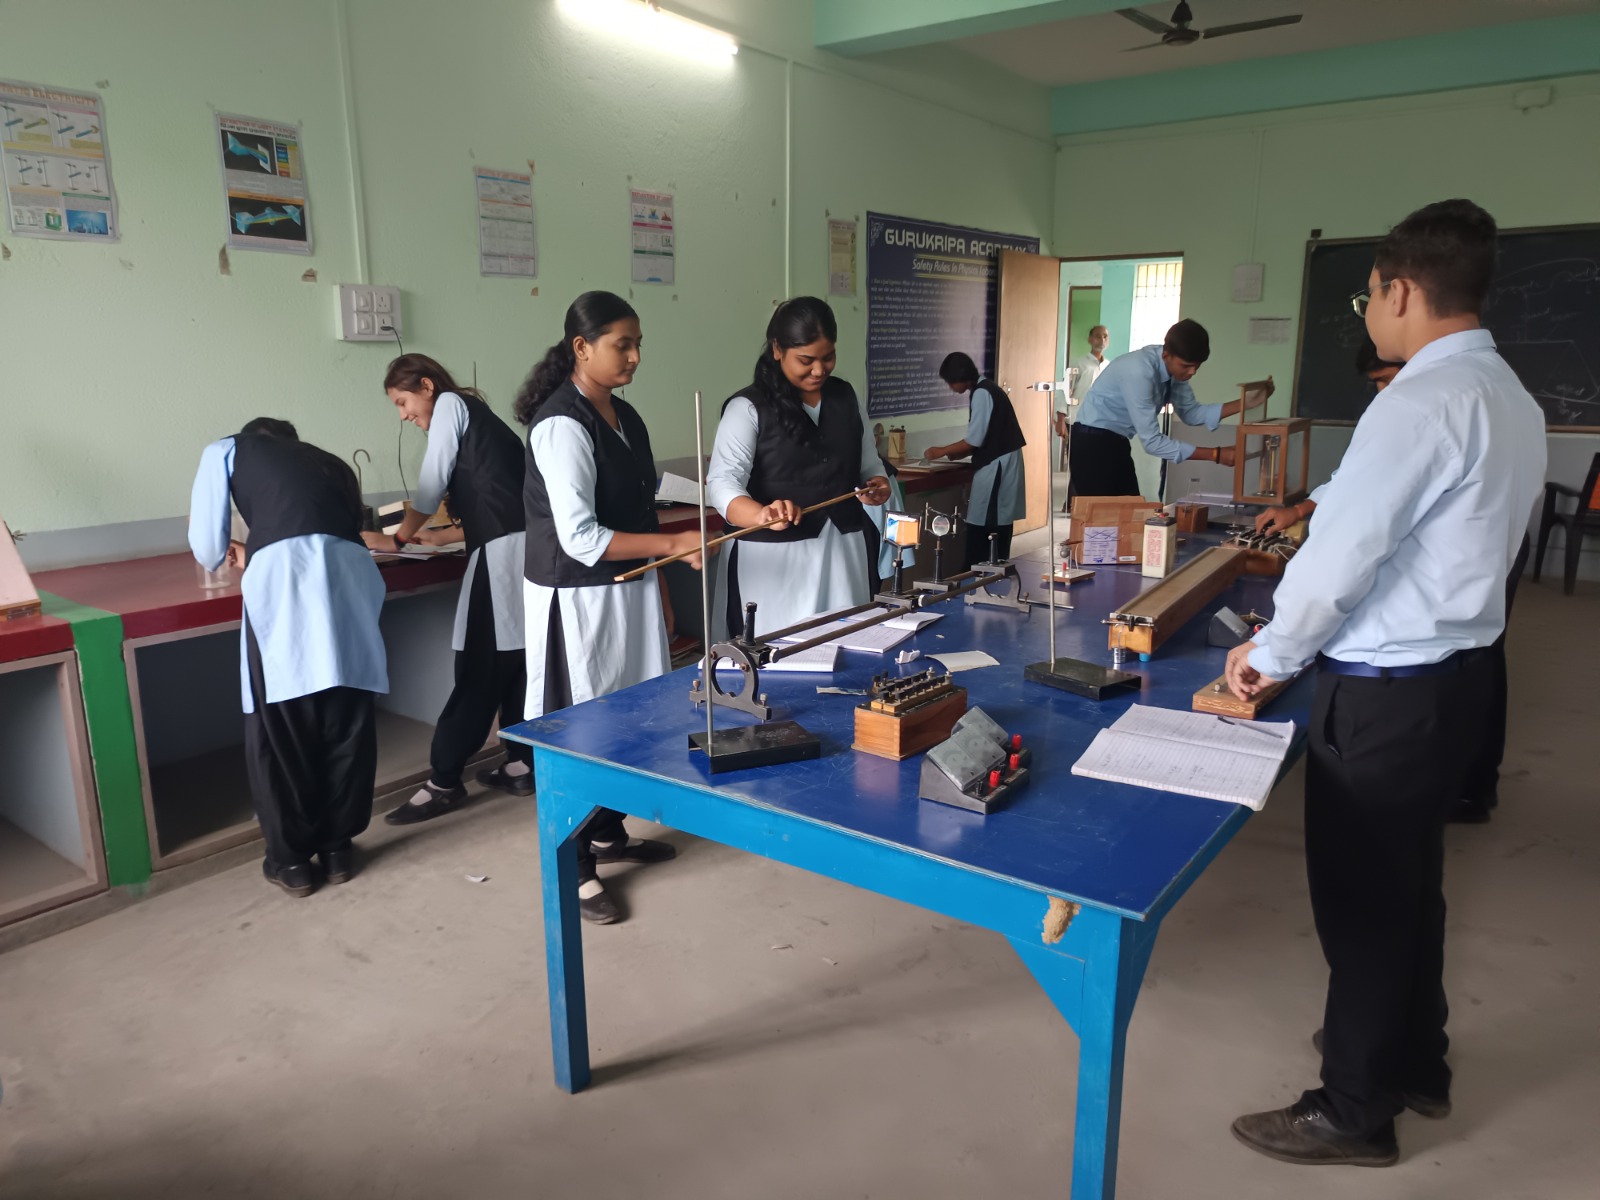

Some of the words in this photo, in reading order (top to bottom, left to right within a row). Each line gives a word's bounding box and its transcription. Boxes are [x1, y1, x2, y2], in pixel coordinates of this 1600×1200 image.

[885, 229, 965, 254] GURUKRIPA
[912, 259, 933, 274] Safety
[934, 261, 951, 273] Rules
[958, 263, 979, 277] Physics
